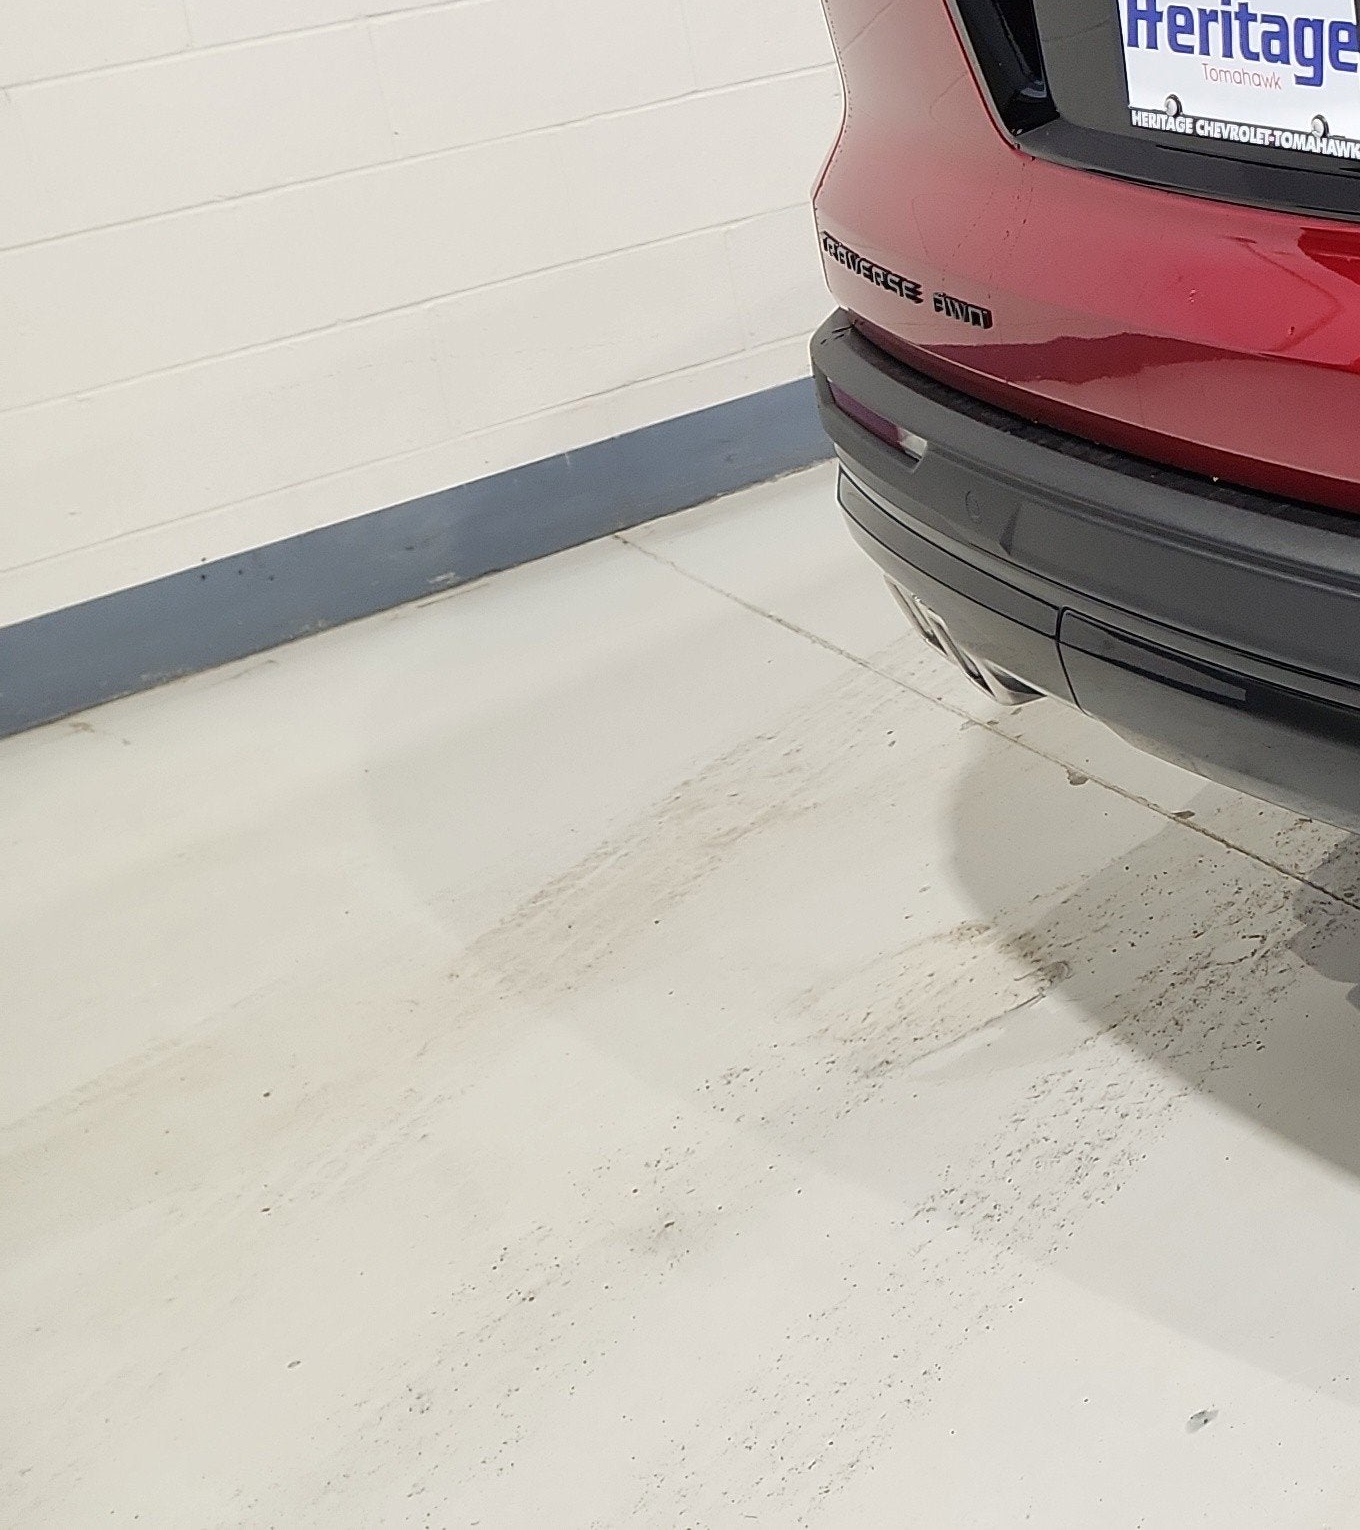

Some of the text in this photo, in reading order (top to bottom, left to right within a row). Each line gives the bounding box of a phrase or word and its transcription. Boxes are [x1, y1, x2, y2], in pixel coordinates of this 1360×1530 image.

[1201, 63, 1282, 90] Tomahawk
[1131, 109, 1193, 135] HERITAGE
[932, 292, 993, 330] AWD
